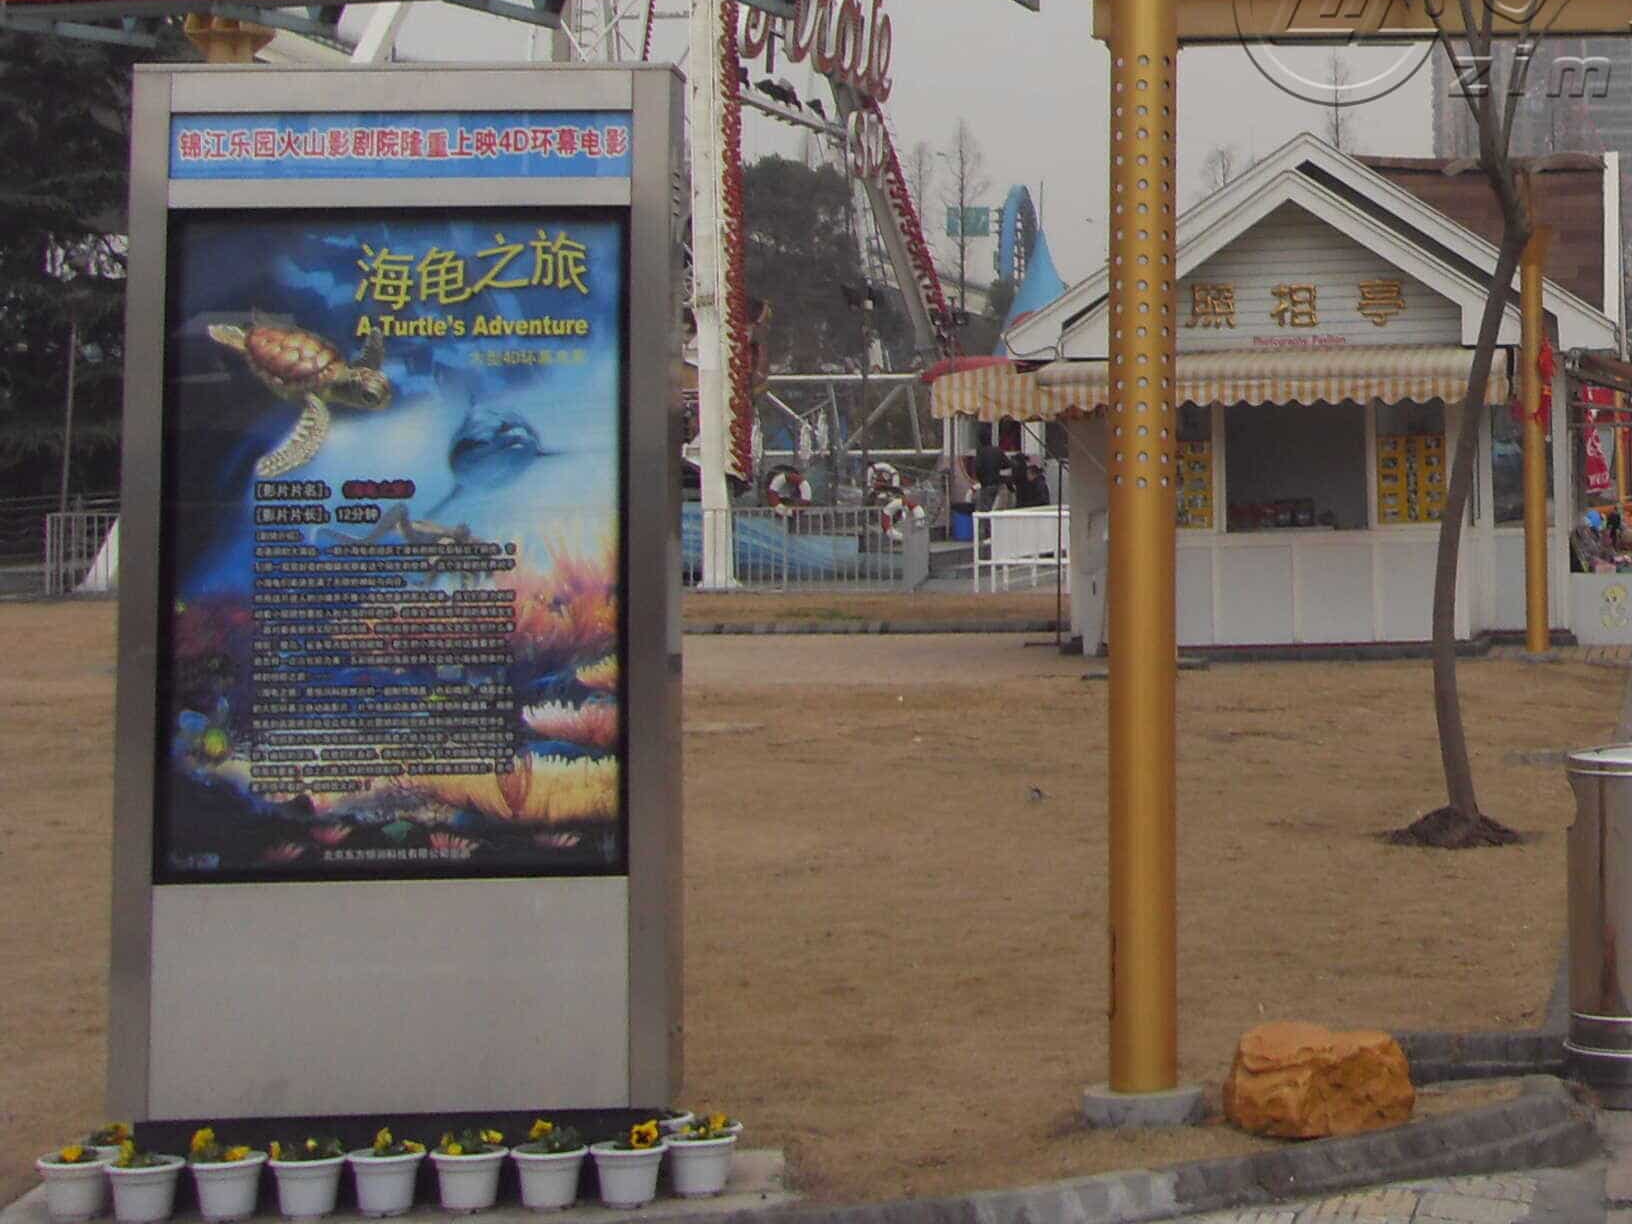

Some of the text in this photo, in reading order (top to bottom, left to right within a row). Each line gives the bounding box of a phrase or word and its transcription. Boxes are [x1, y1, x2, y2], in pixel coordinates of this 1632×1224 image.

[179, 128, 628, 159] 锦江乐园火山影剧院隆重上映4D环幕电影
[354, 229, 589, 310] 海龟之旅
[1185, 279, 1405, 328] 照相亭
[356, 315, 589, 337] A Turtle's Adventure
